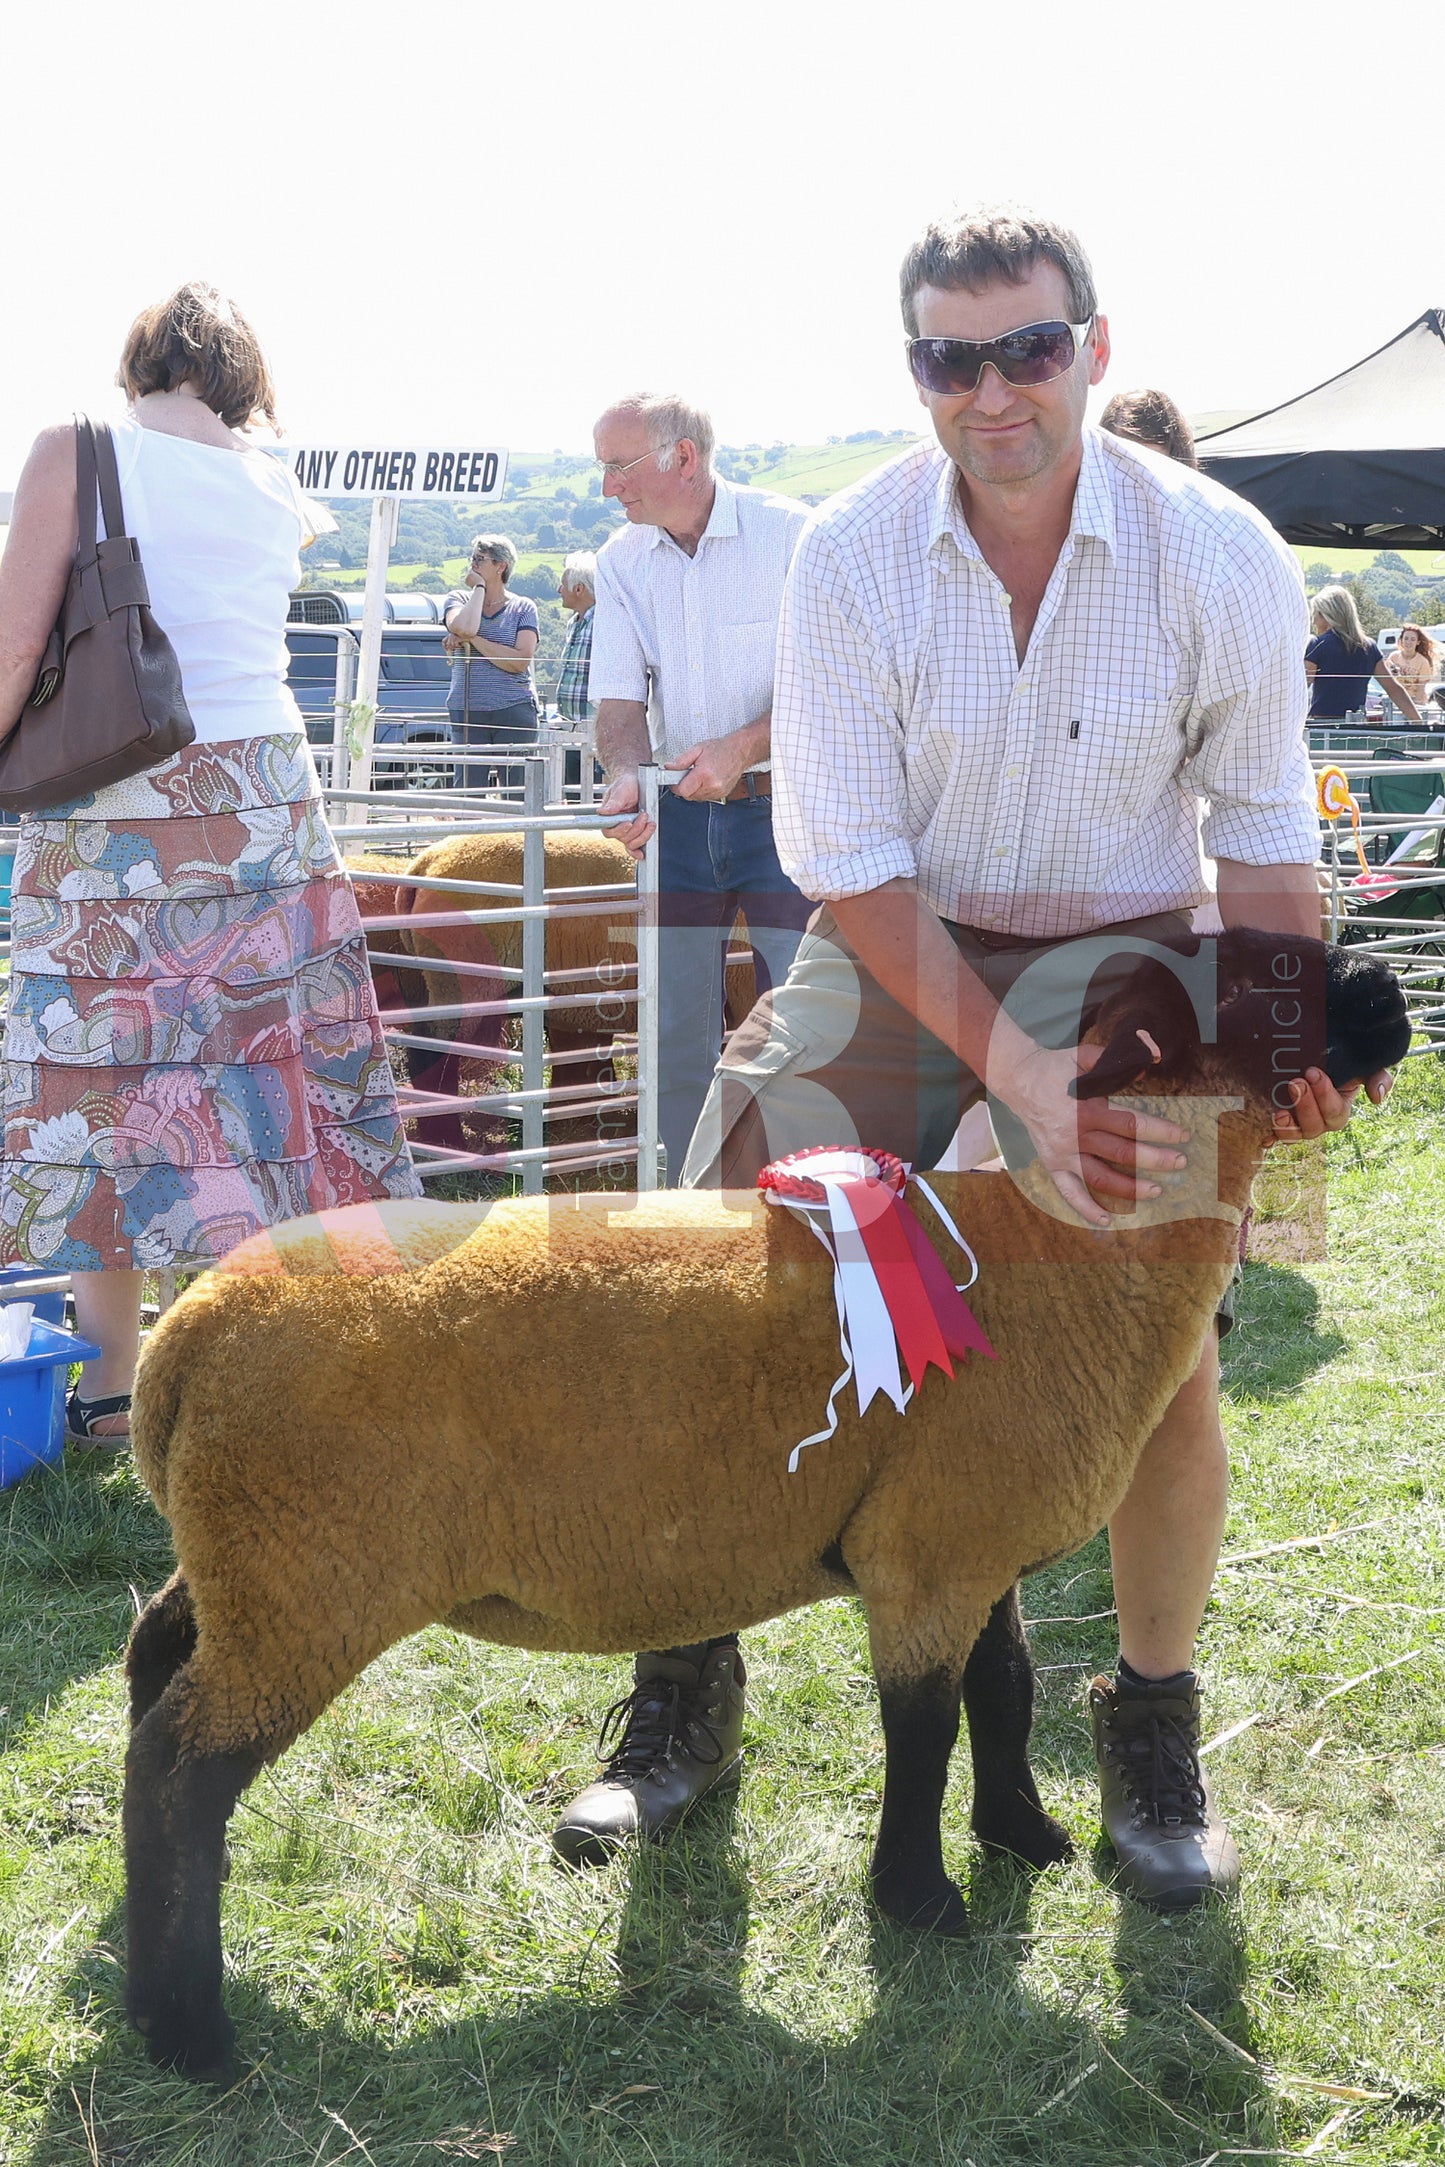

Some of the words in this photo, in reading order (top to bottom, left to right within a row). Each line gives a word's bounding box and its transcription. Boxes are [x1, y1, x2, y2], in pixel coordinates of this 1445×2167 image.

[294, 450, 339, 489] ANY
[343, 450, 416, 491] OTHER
[423, 451, 499, 493] BREED
